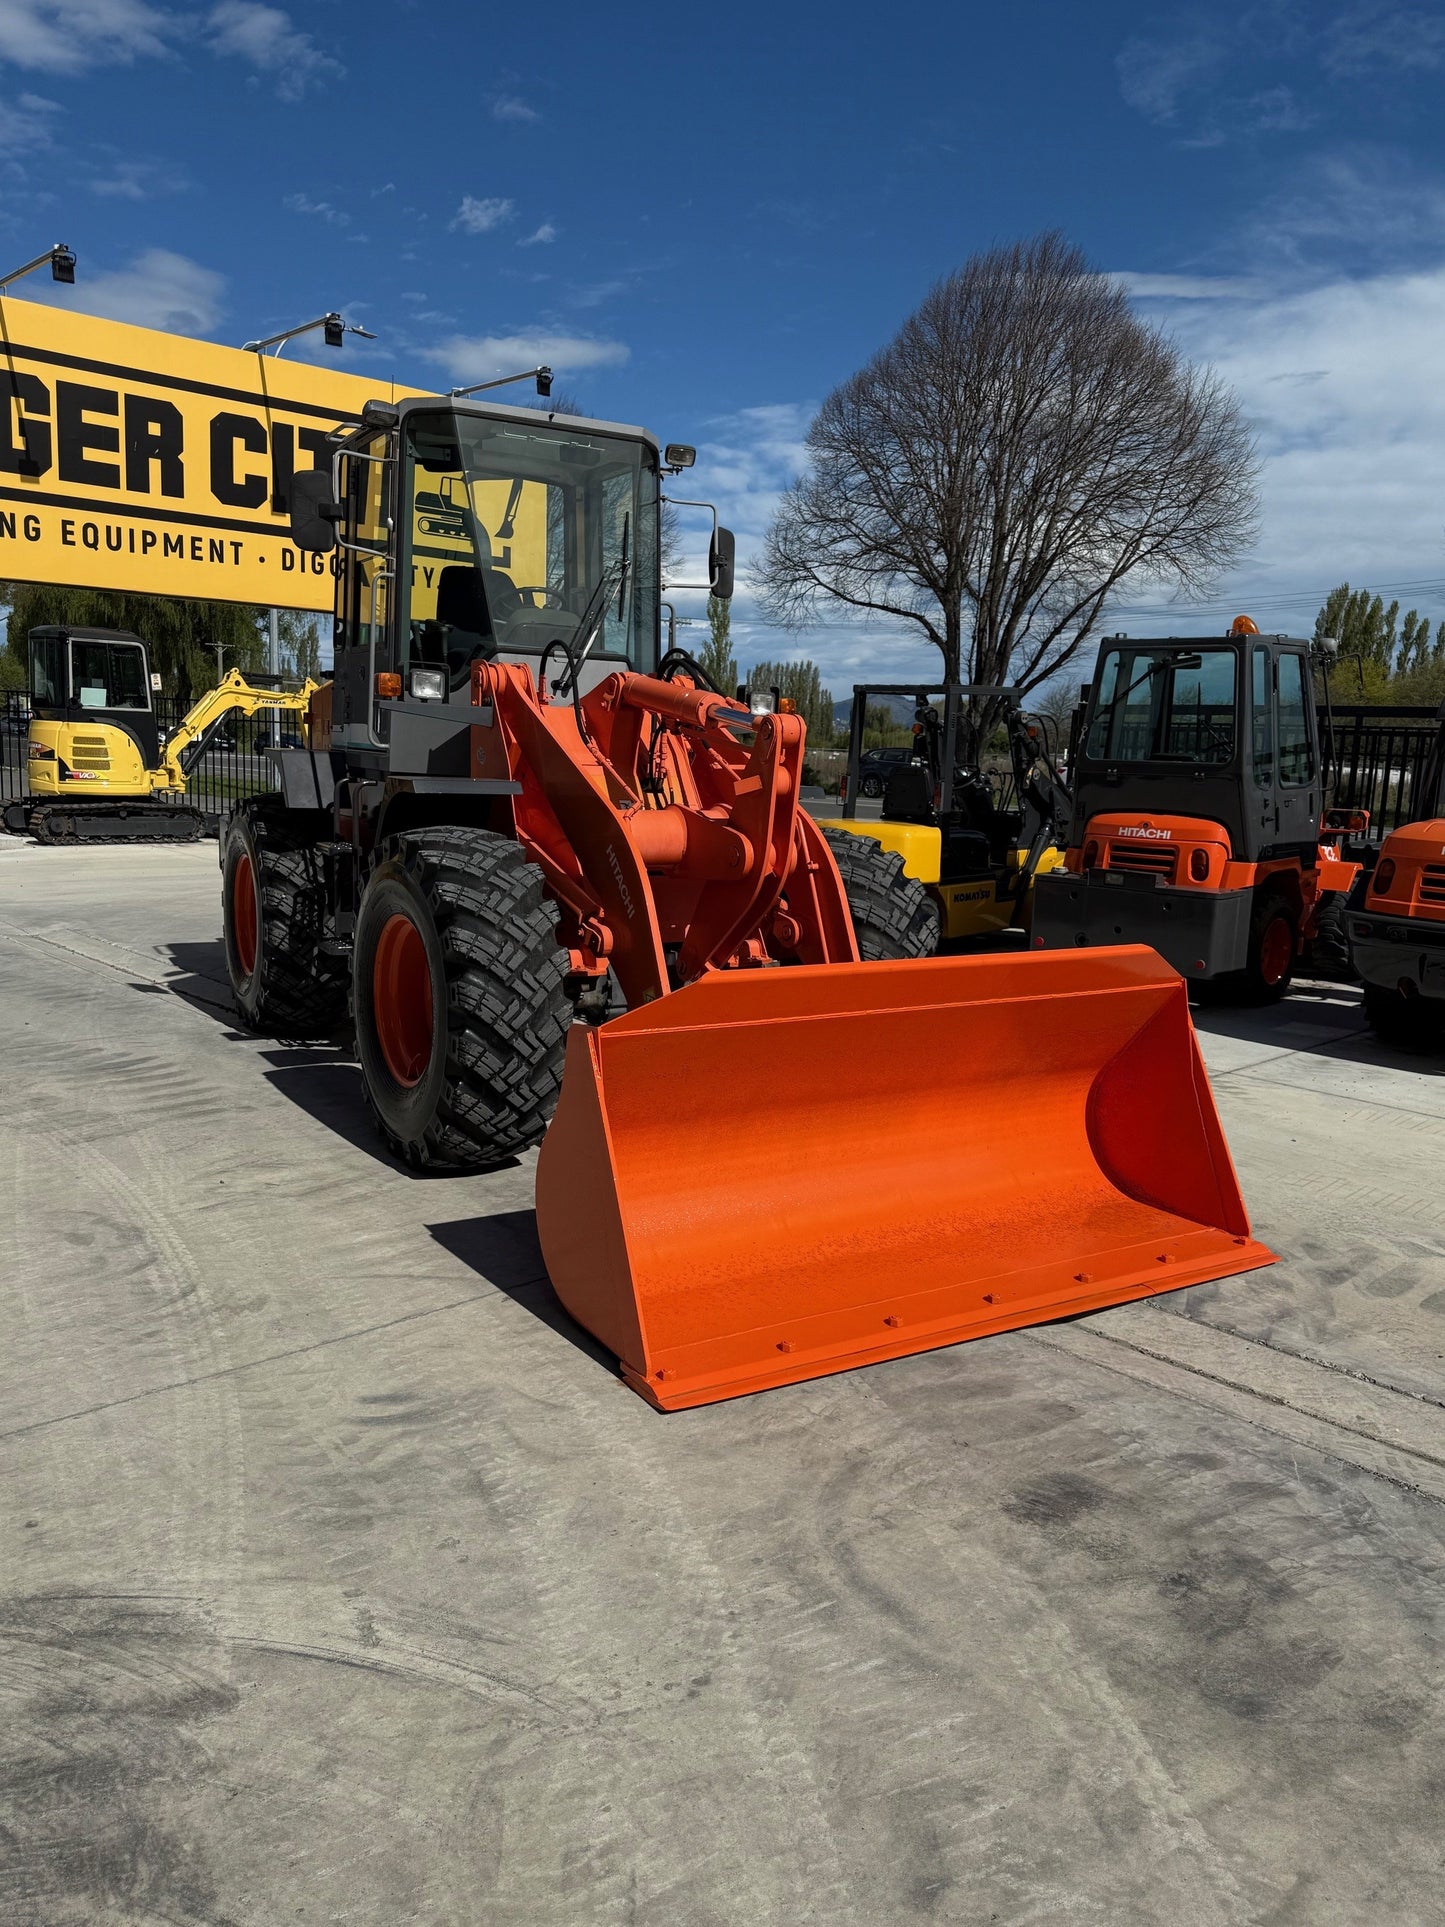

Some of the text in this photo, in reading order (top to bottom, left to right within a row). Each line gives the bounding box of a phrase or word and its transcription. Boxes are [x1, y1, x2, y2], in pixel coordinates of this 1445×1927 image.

[62, 519, 243, 566] EQUIPMENT
[1118, 826, 1171, 840] HITACHI
[606, 844, 635, 919] HITACHI
[953, 888, 991, 903] KOMATSU
